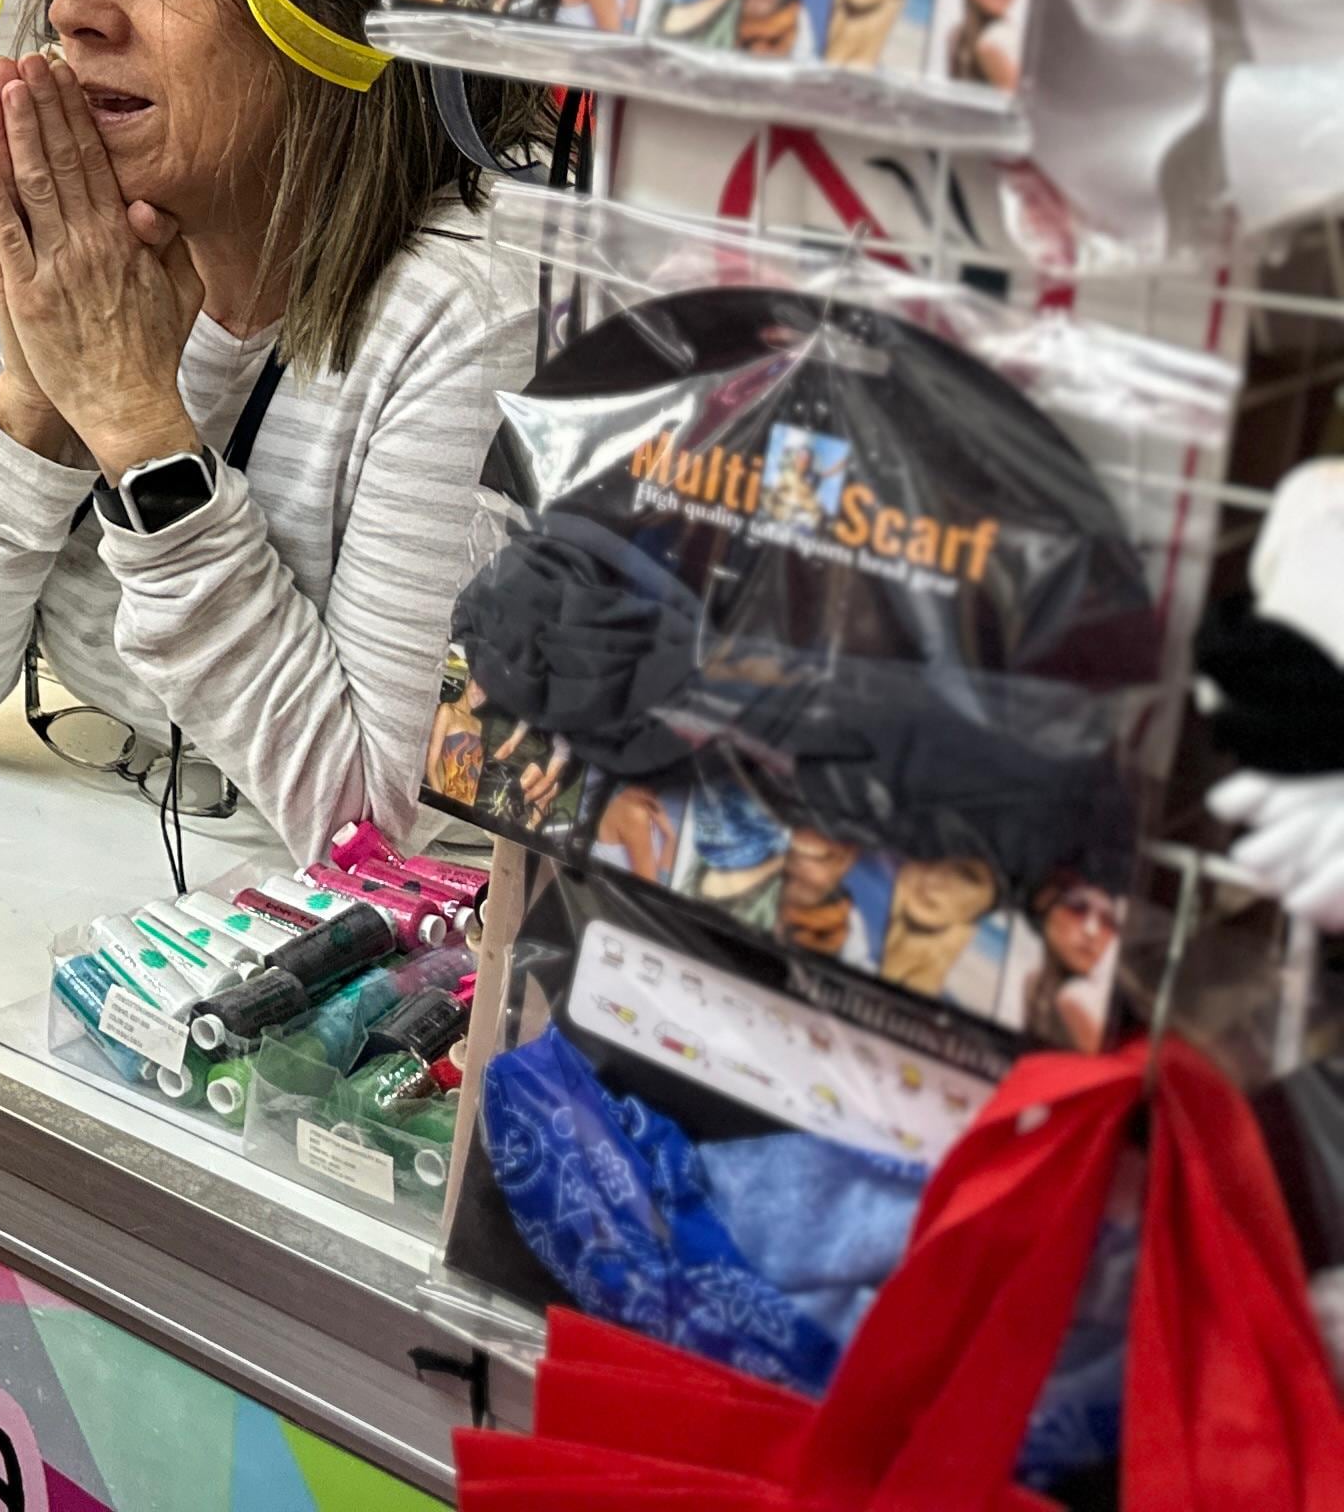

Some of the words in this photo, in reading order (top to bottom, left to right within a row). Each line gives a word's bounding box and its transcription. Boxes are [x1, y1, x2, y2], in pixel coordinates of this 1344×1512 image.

[630, 430, 763, 514] Multi
[834, 480, 999, 583] Scarf
[634, 483, 680, 511] High
[683, 498, 745, 533] quality
